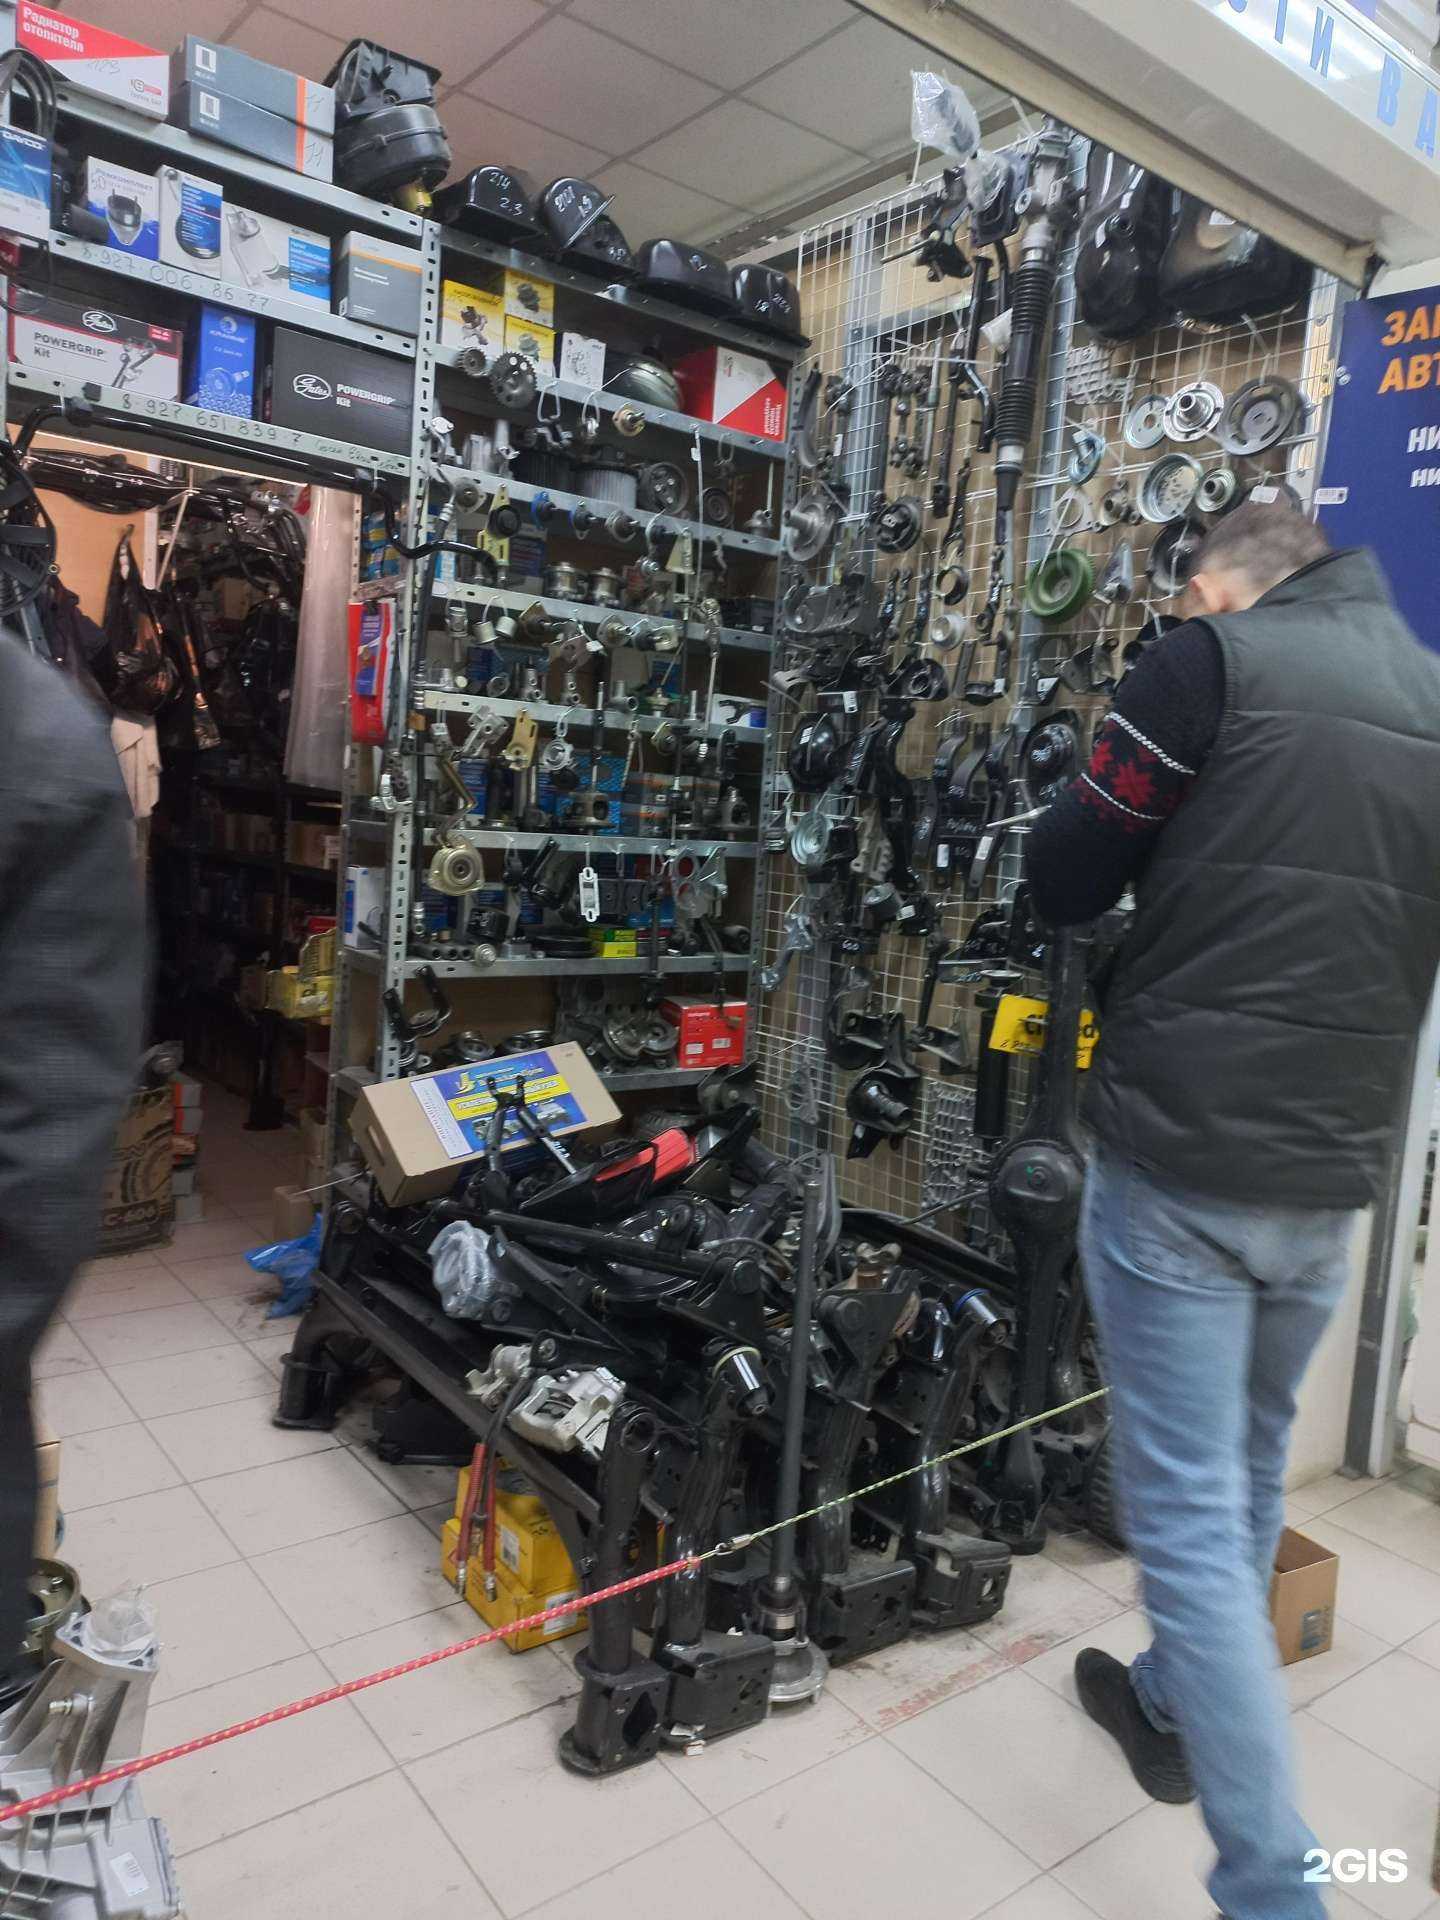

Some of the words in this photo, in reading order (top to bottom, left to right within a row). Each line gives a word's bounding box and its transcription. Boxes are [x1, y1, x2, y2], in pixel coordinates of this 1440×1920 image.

[23, 6, 79, 38] Радиатор
[1381, 303, 1440, 347] ЗА
[33, 346, 51, 359] Kit
[34, 331, 105, 358] POWERGRIP
[336, 383, 396, 405] POWERGRIP
